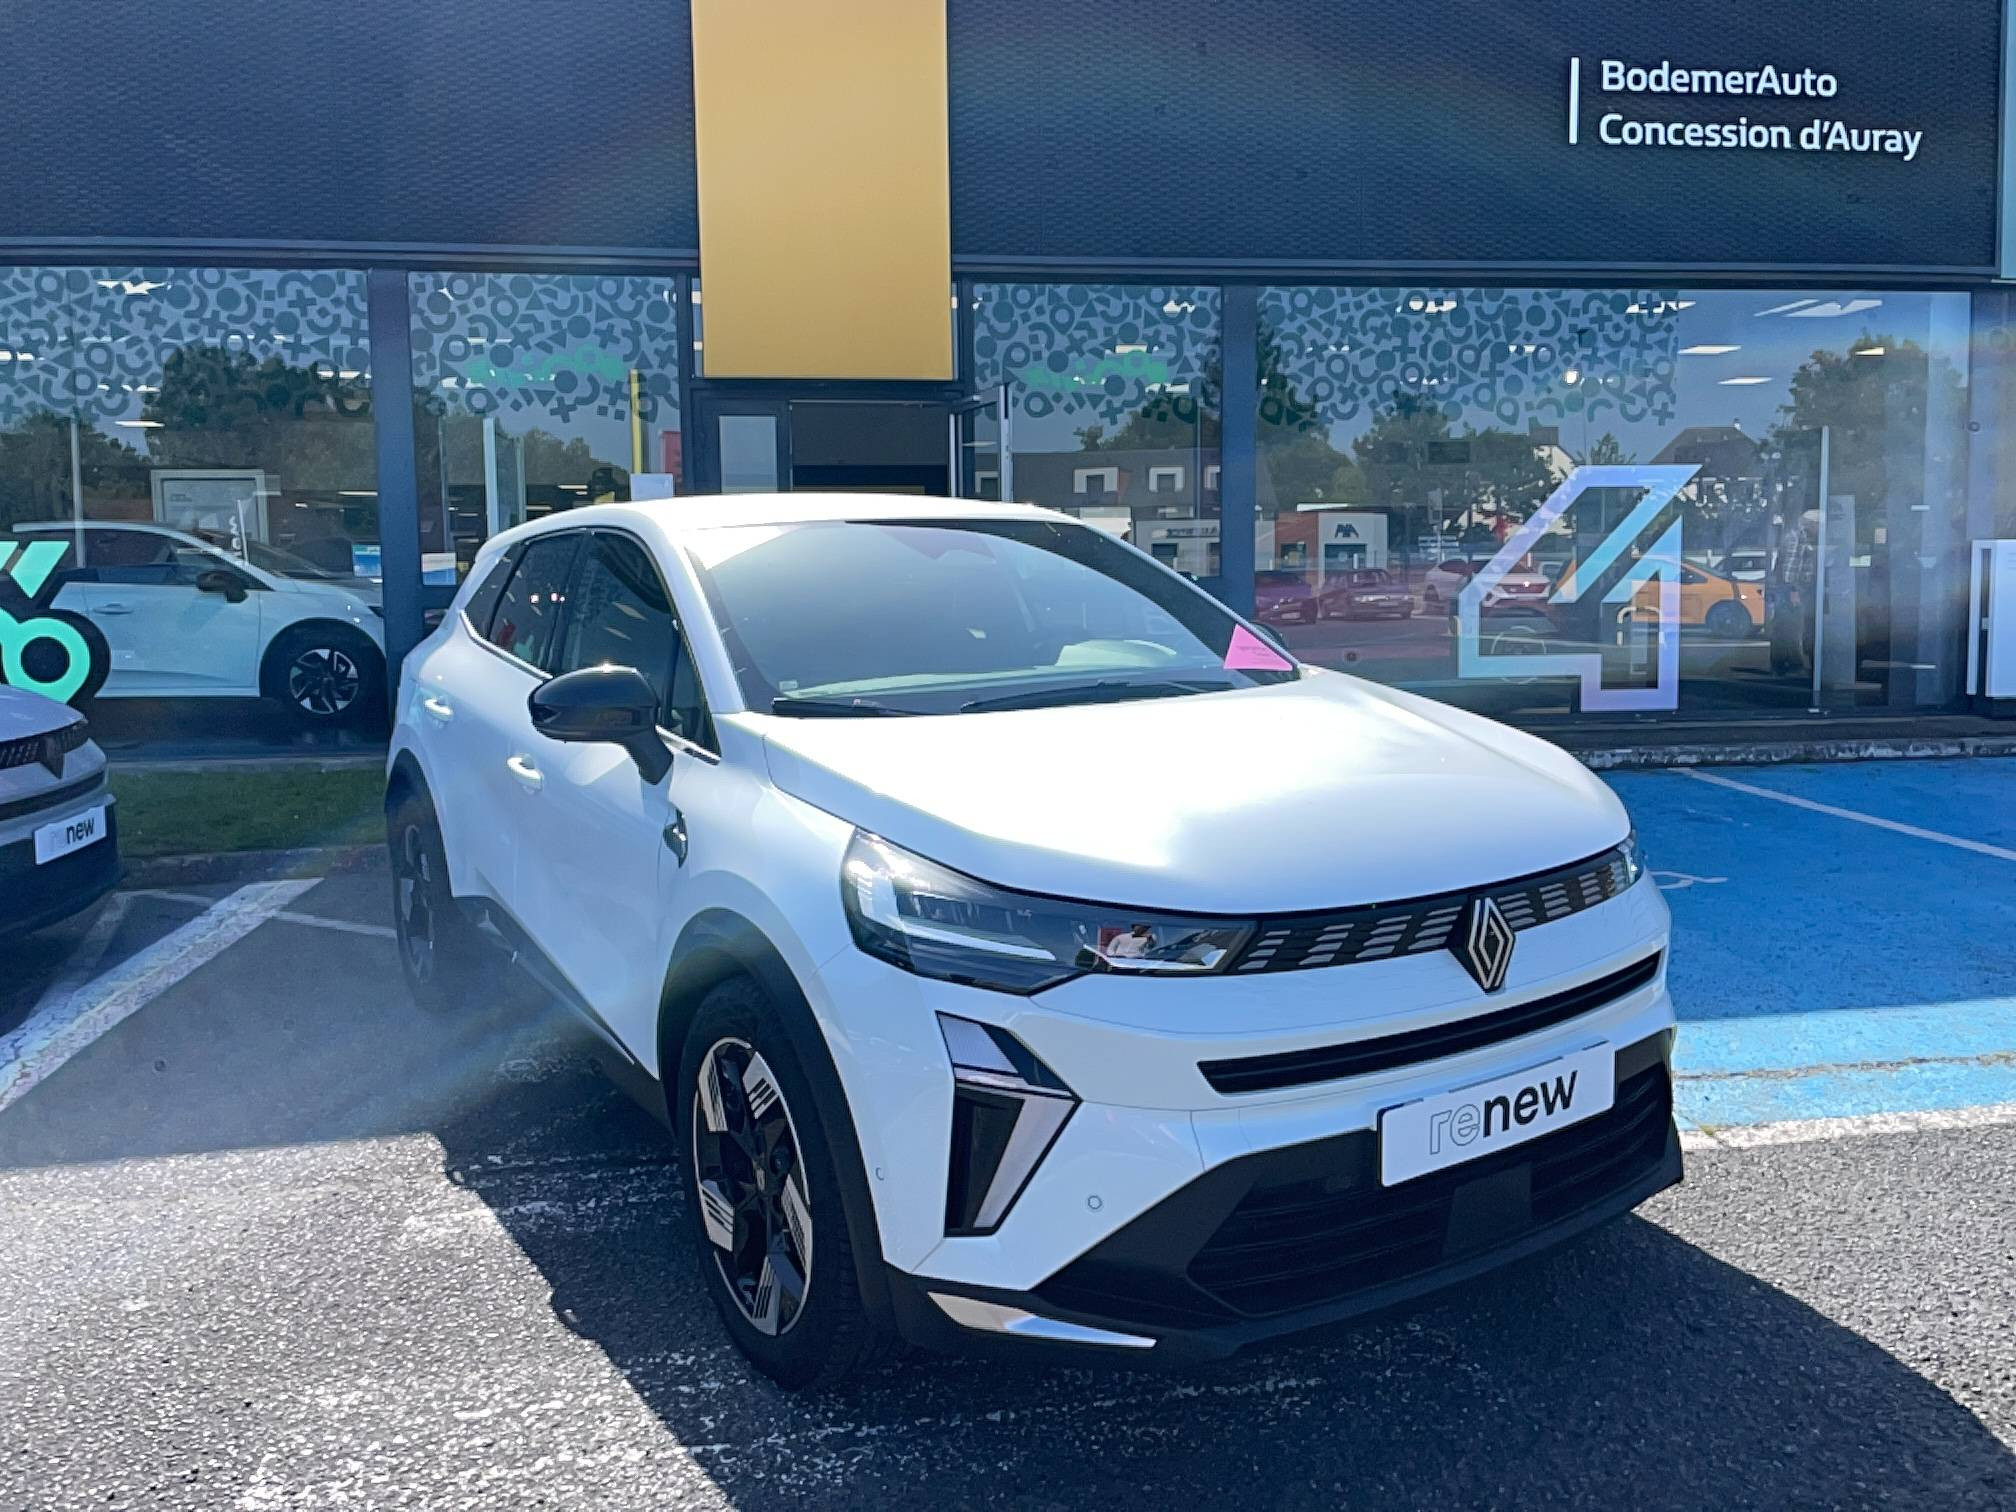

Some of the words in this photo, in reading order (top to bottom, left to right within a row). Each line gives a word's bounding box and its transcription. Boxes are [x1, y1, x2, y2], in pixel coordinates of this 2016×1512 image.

[1601, 60, 1838, 97] BodemerAuto
[1599, 113, 1791, 148] Concession
[1799, 119, 1923, 161] d'Auray
[1429, 1070, 1578, 1155] renew
